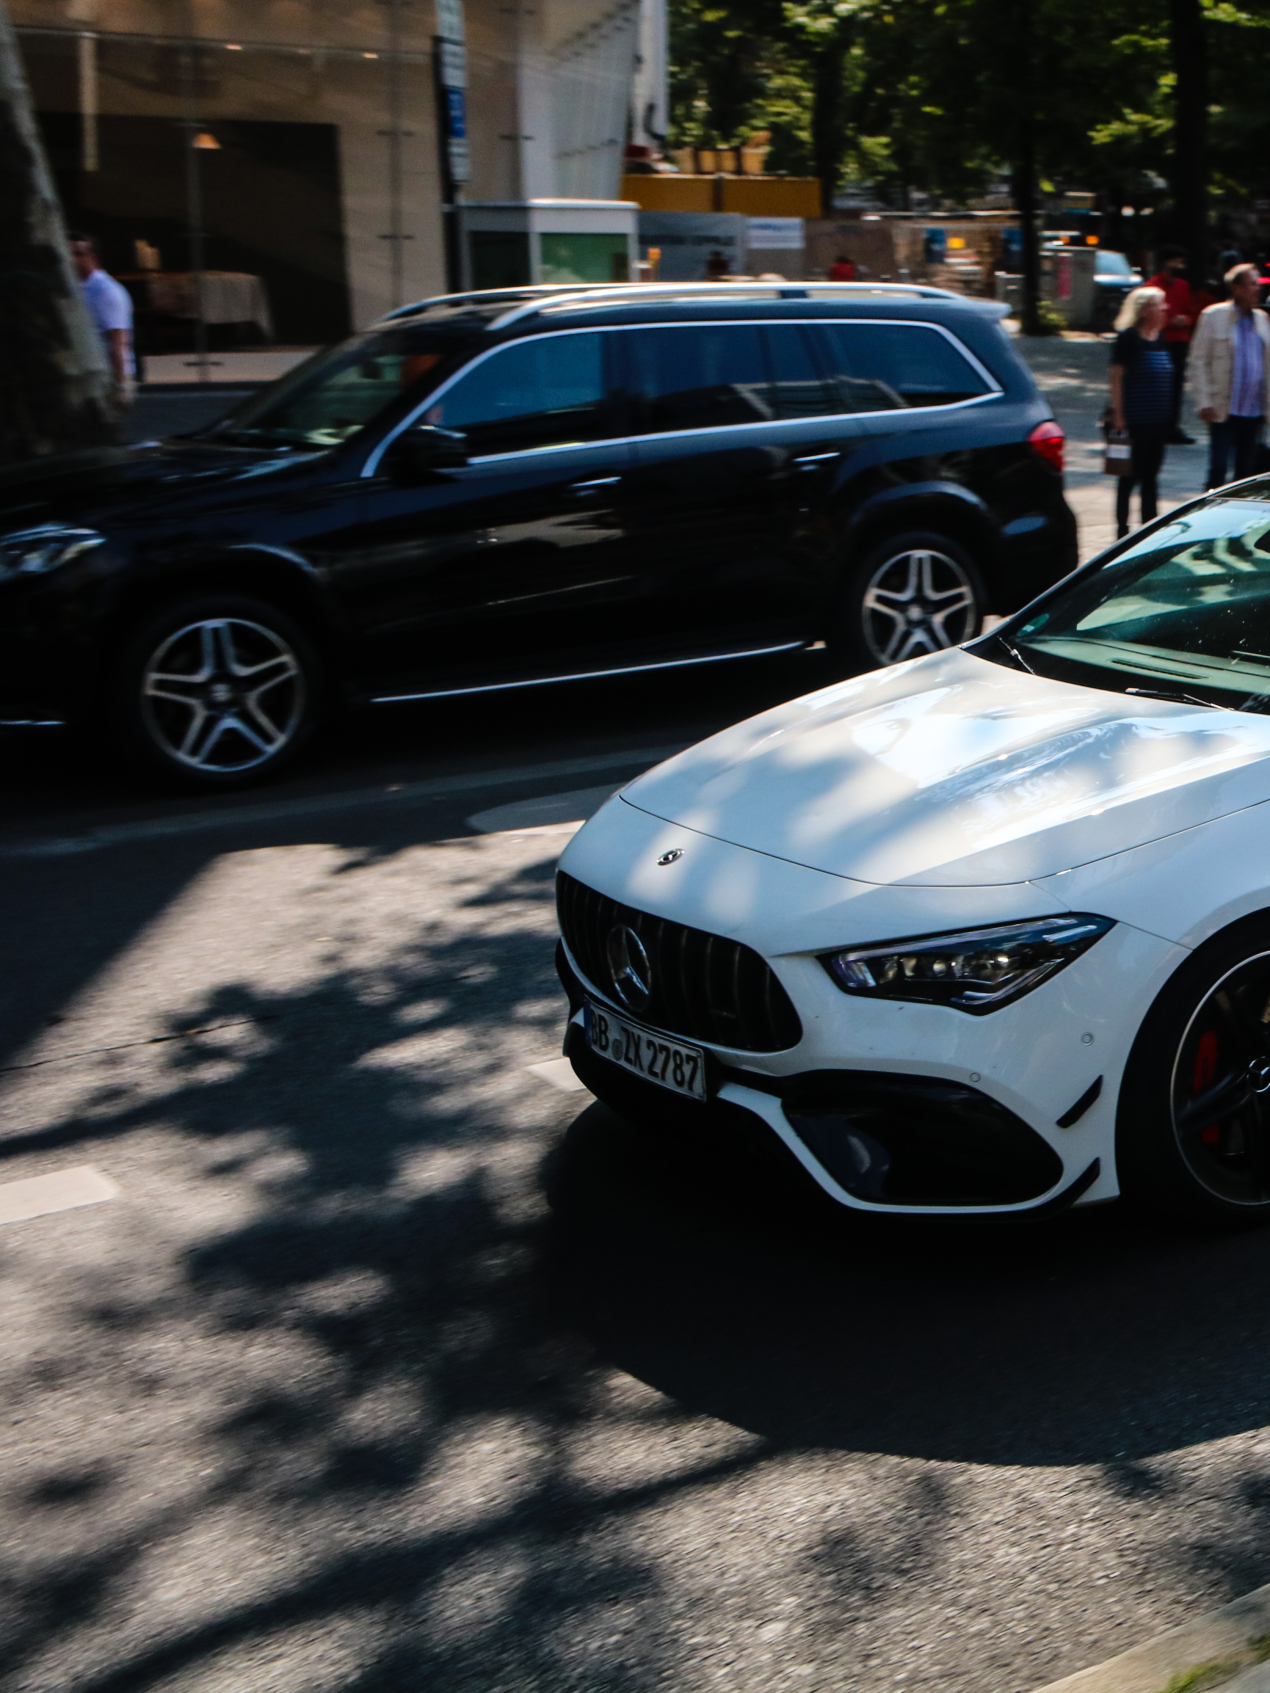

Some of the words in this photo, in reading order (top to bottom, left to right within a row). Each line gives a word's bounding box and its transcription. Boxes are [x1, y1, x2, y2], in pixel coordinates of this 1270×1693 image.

[591, 1008, 609, 1052] BB
[621, 1026, 645, 1072] ZX
[646, 1039, 699, 1092] 2787
